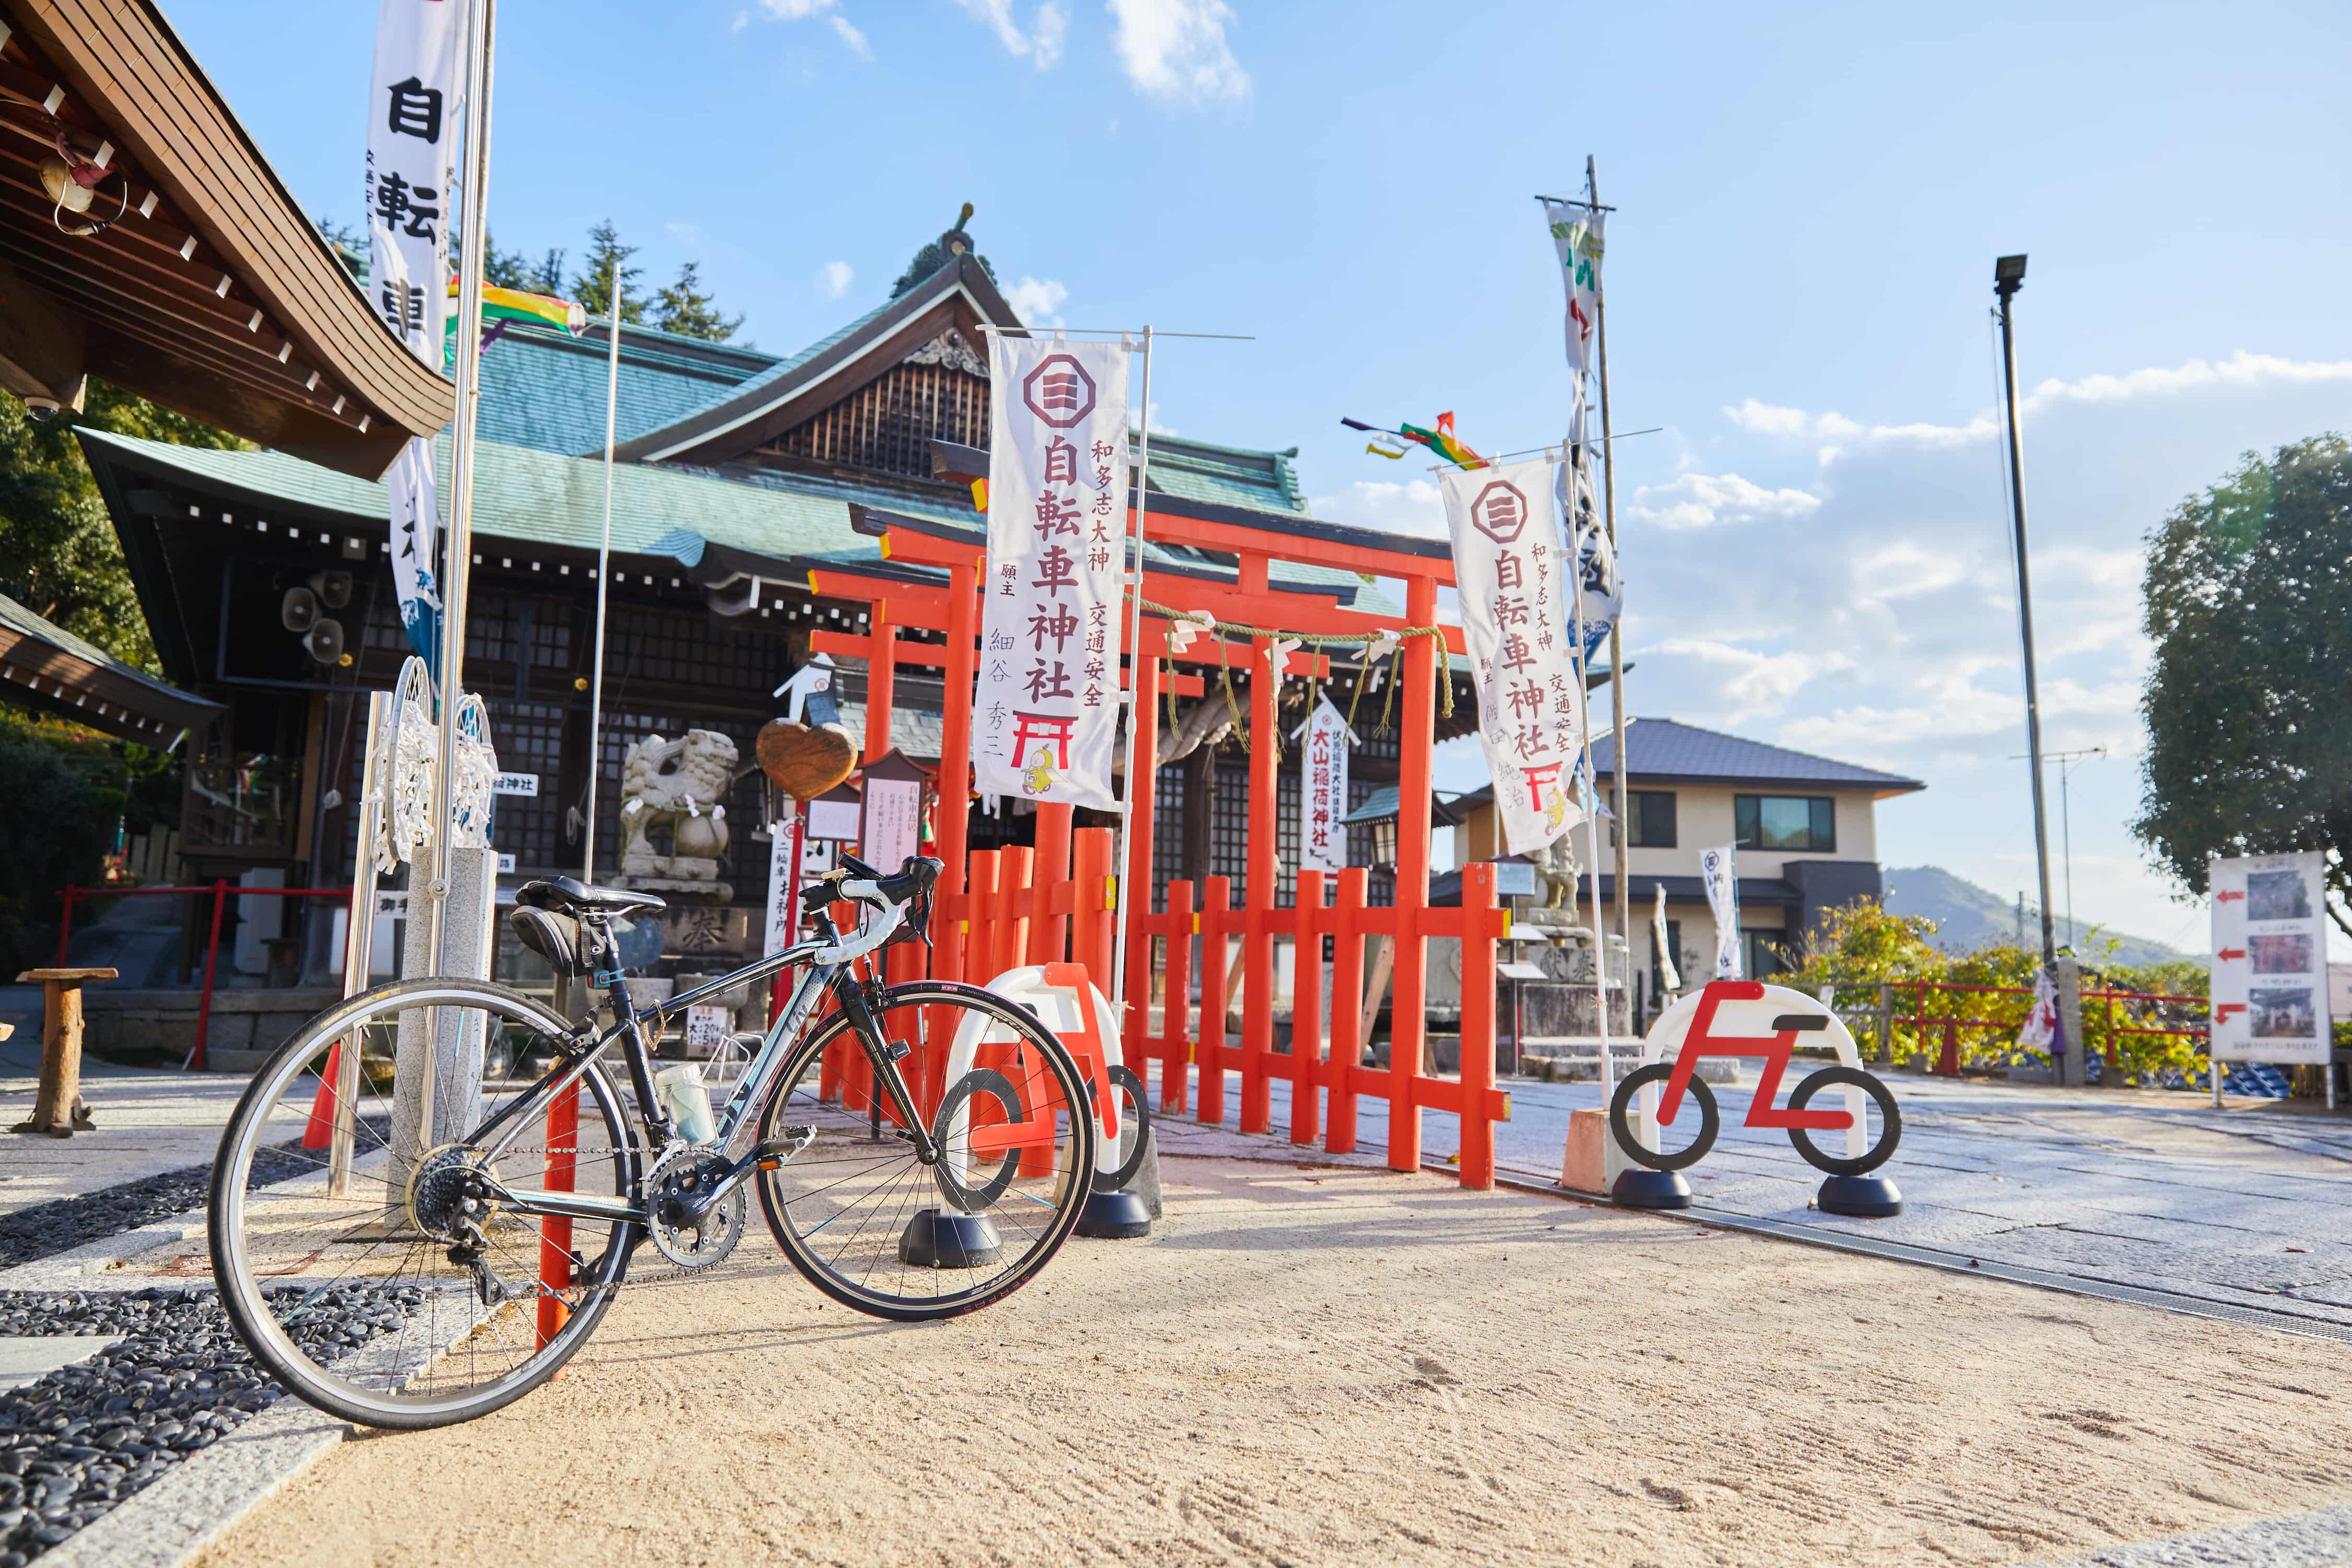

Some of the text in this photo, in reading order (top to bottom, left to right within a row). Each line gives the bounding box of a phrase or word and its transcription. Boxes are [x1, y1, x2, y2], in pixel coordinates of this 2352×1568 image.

[1088, 440, 1114, 572] 和多志大神
[1000, 564, 1017, 596] 願主
[1022, 435, 1082, 704] 自転車神社
[1531, 543, 1553, 652] 和多志大神
[1082, 602, 1108, 707] 交通安全
[1493, 549, 1550, 761] 自転車神社
[1549, 674, 1572, 753] 交通安全
[1312, 729, 1329, 847] 大山稲荷神社
[785, 1004, 810, 1033] Liv
